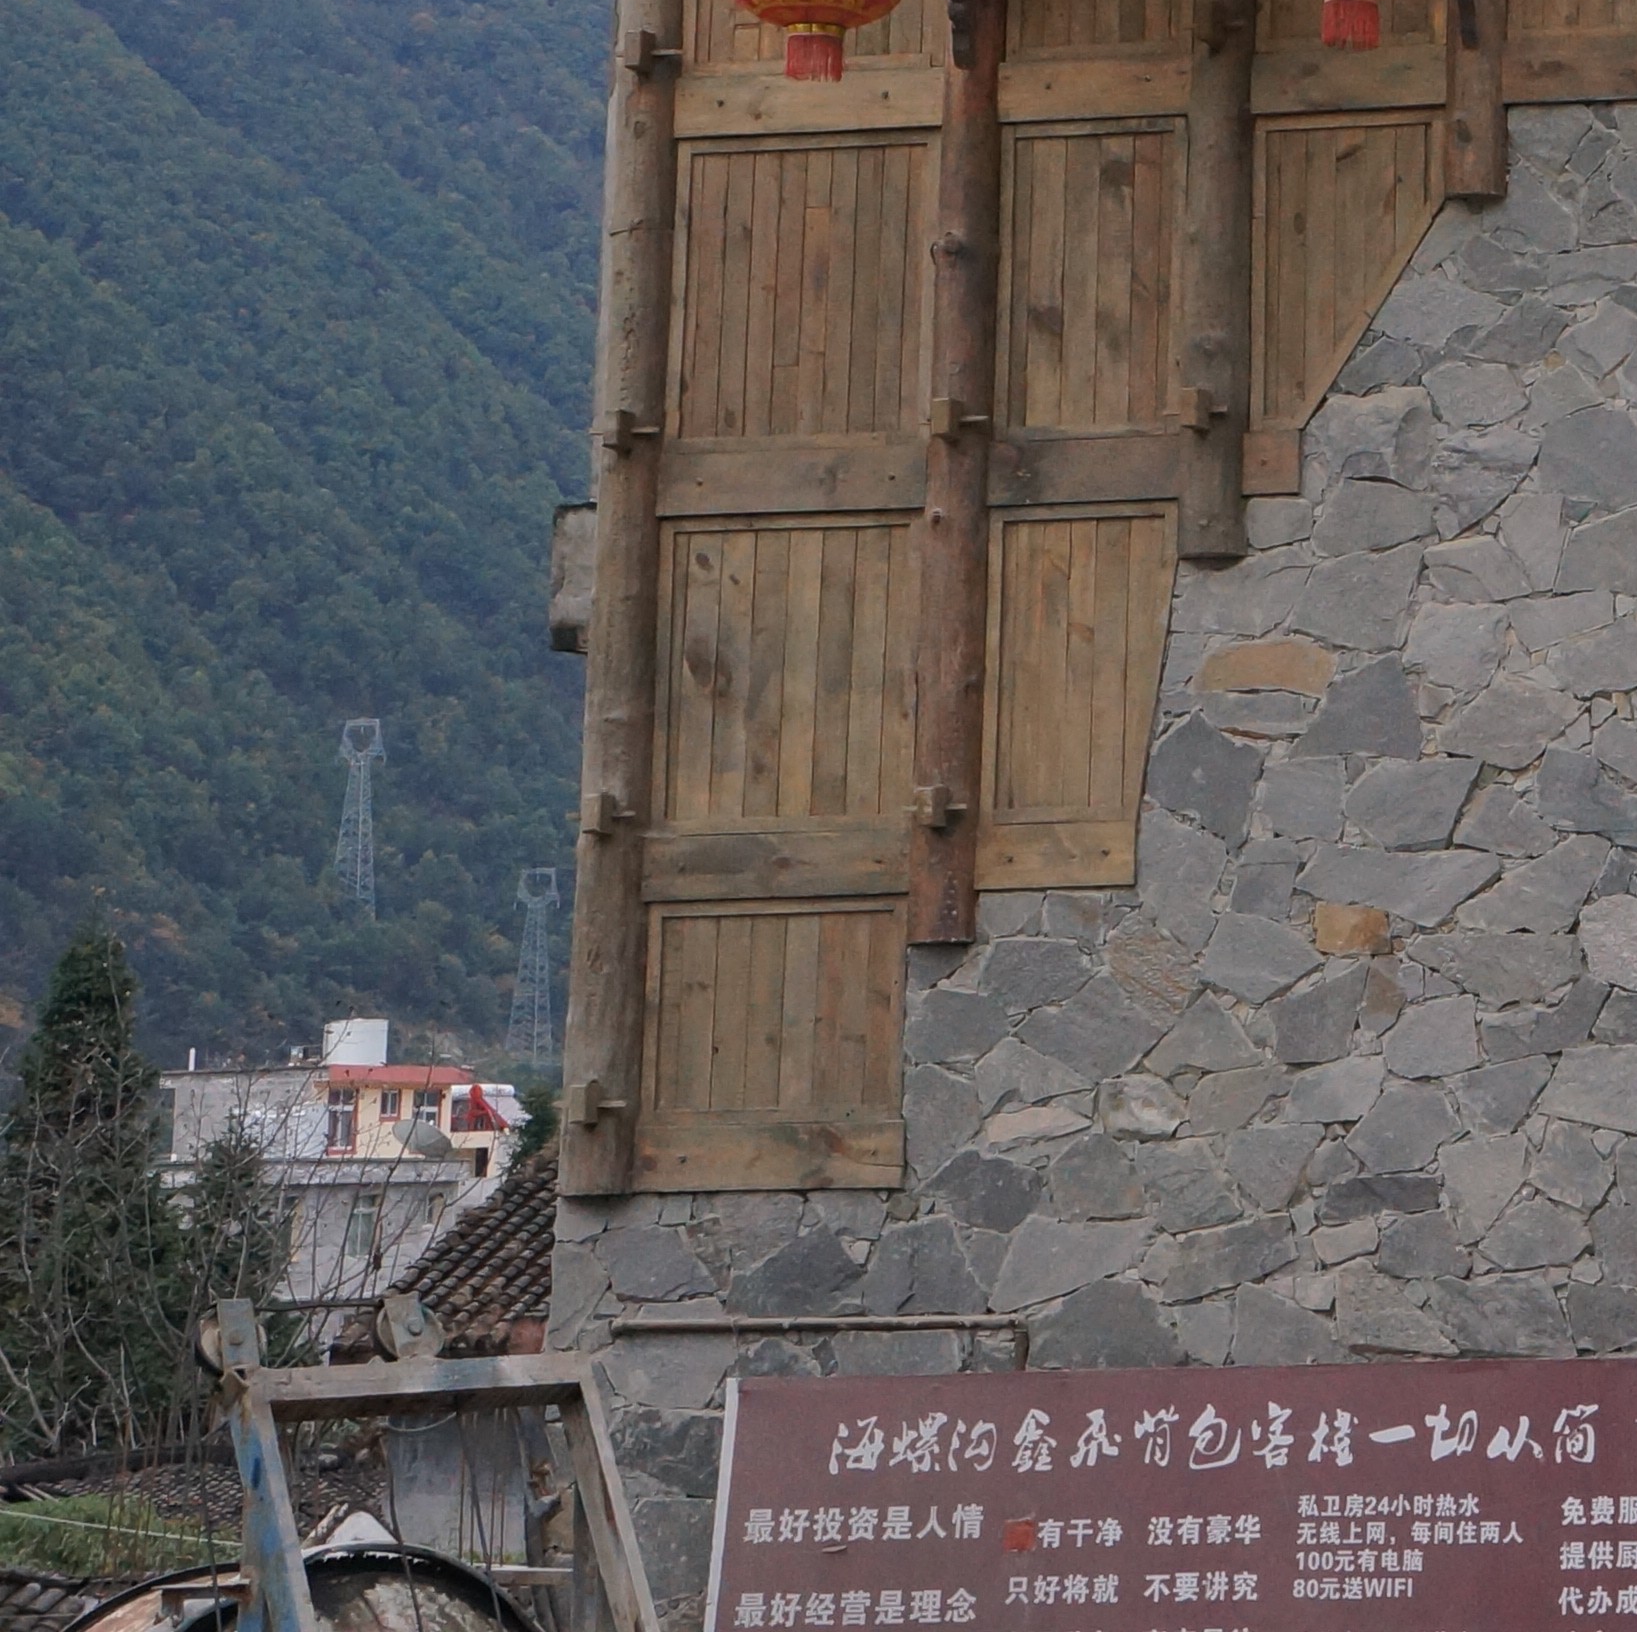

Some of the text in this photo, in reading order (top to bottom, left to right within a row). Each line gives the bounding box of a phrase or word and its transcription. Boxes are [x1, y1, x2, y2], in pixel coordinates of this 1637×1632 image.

[1297, 1493, 1480, 1518] 私卫房24小时热水
[744, 1504, 984, 1544] 最好投资是人情
[1005, 1514, 1261, 1551] 有干净 没有豪华
[1296, 1549, 1424, 1573] 100元有电脑
[1005, 1571, 1258, 1605] 只好将就 不要讲究
[1292, 1577, 1413, 1600] 80元送WIFI
[735, 1588, 977, 1628] 最好经营是理念
